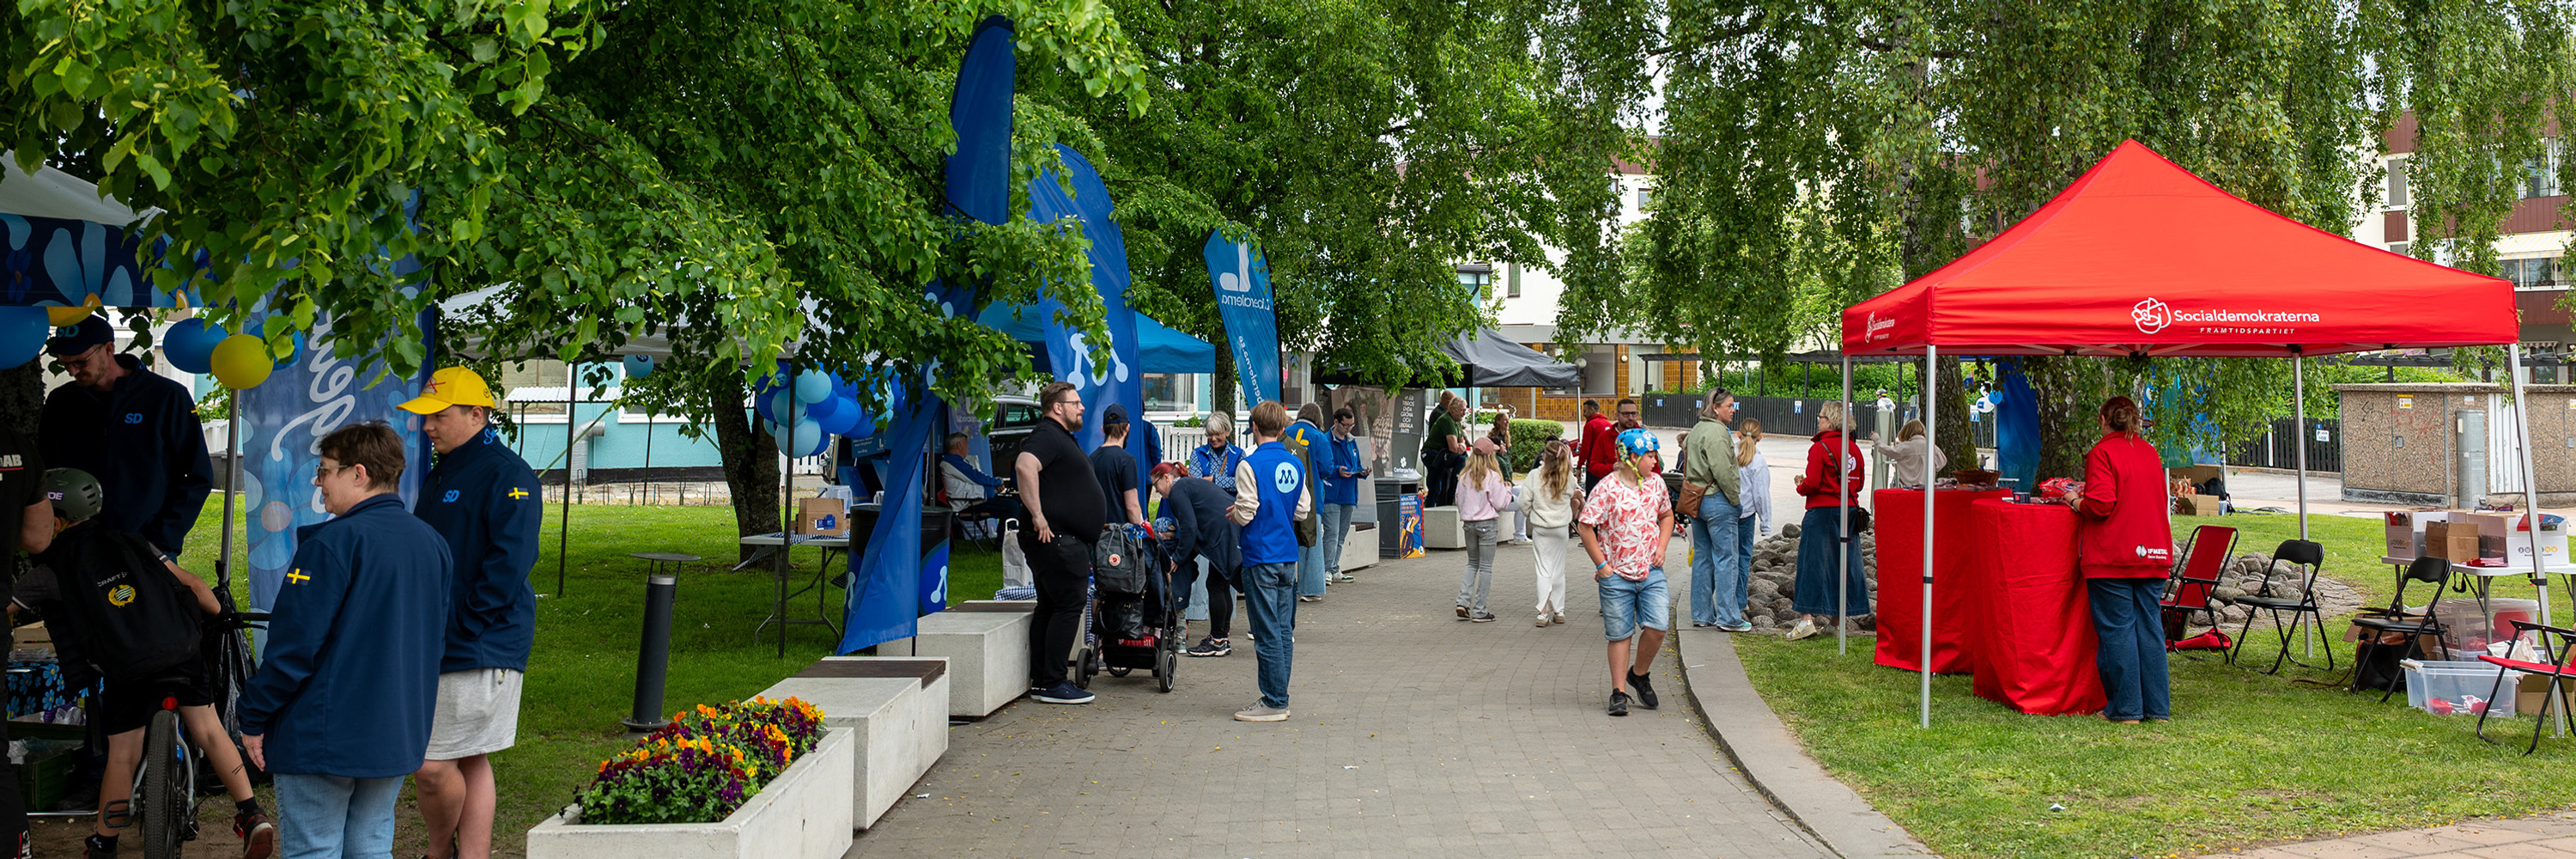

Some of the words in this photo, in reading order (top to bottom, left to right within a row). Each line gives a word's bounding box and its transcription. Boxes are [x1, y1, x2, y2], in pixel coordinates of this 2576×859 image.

[2173, 309, 2320, 322] Socialdemokraterna
[57, 324, 80, 338] SD
[125, 413, 143, 423] SD
[442, 490, 460, 503] SD
